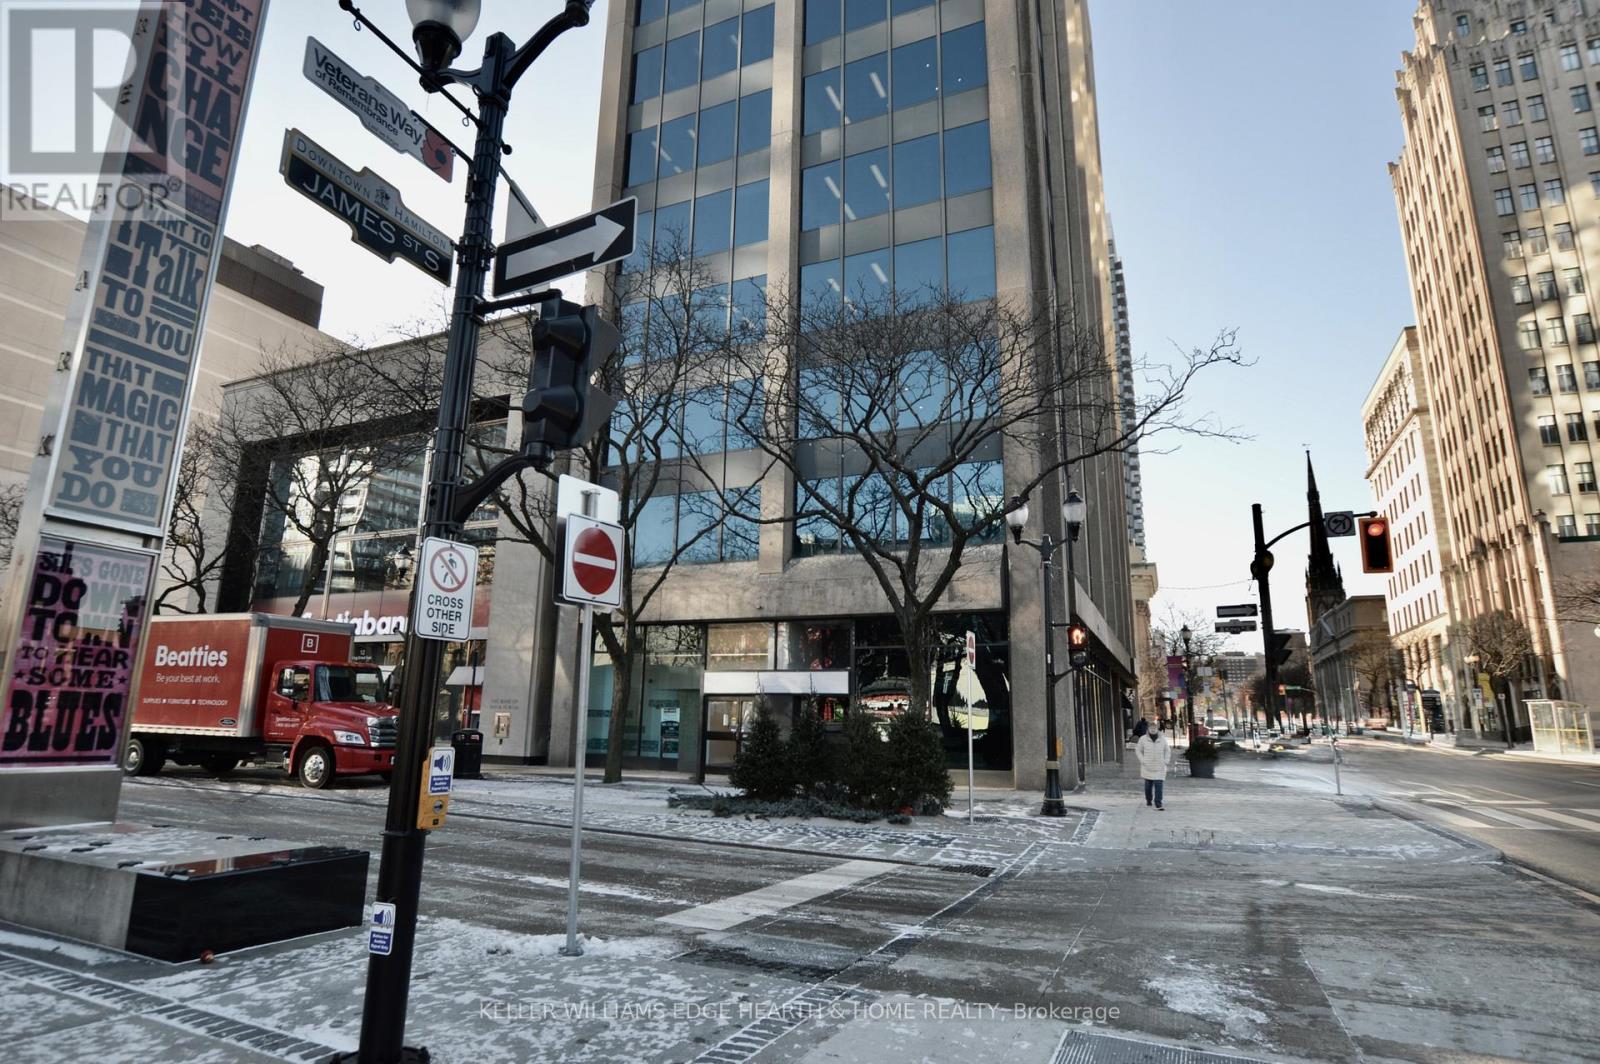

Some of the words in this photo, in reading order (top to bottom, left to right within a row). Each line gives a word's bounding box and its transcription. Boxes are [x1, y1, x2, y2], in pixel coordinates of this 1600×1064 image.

[168, 2, 244, 67] HOW
[184, 0, 252, 50] EE
[314, 47, 389, 118] Veterans
[390, 105, 423, 146] Way
[315, 68, 327, 80] of
[328, 77, 399, 136] Remembrance
[296, 138, 371, 200] DOWNTOWN
[394, 206, 447, 250] HAMILTON
[142, 203, 189, 238] WANT
[191, 226, 212, 250] TO
[303, 173, 396, 245] JAMES
[402, 233, 422, 253] ST
[424, 249, 440, 272] S
[133, 220, 204, 310] Talk
[102, 275, 144, 318] TO
[145, 316, 193, 356] YOU
[86, 345, 153, 388] THAT
[77, 371, 178, 432] MAGIC
[105, 418, 173, 465] THAT
[69, 444, 163, 488] YOU
[57, 471, 117, 509] DO
[98, 560, 146, 585] GONE
[426, 607, 462, 622] OTHER
[427, 594, 464, 610] CROSS
[306, 638, 314, 648] B
[431, 621, 455, 635] SIDE
[21, 646, 49, 661] TO
[55, 648, 129, 669] HEAR
[26, 666, 116, 689] SOME
[154, 645, 228, 668] Beatties
[156, 672, 165, 682] Be
[164, 675, 179, 684] your
[180, 673, 194, 683] best
[2, 690, 122, 752] BLUES
